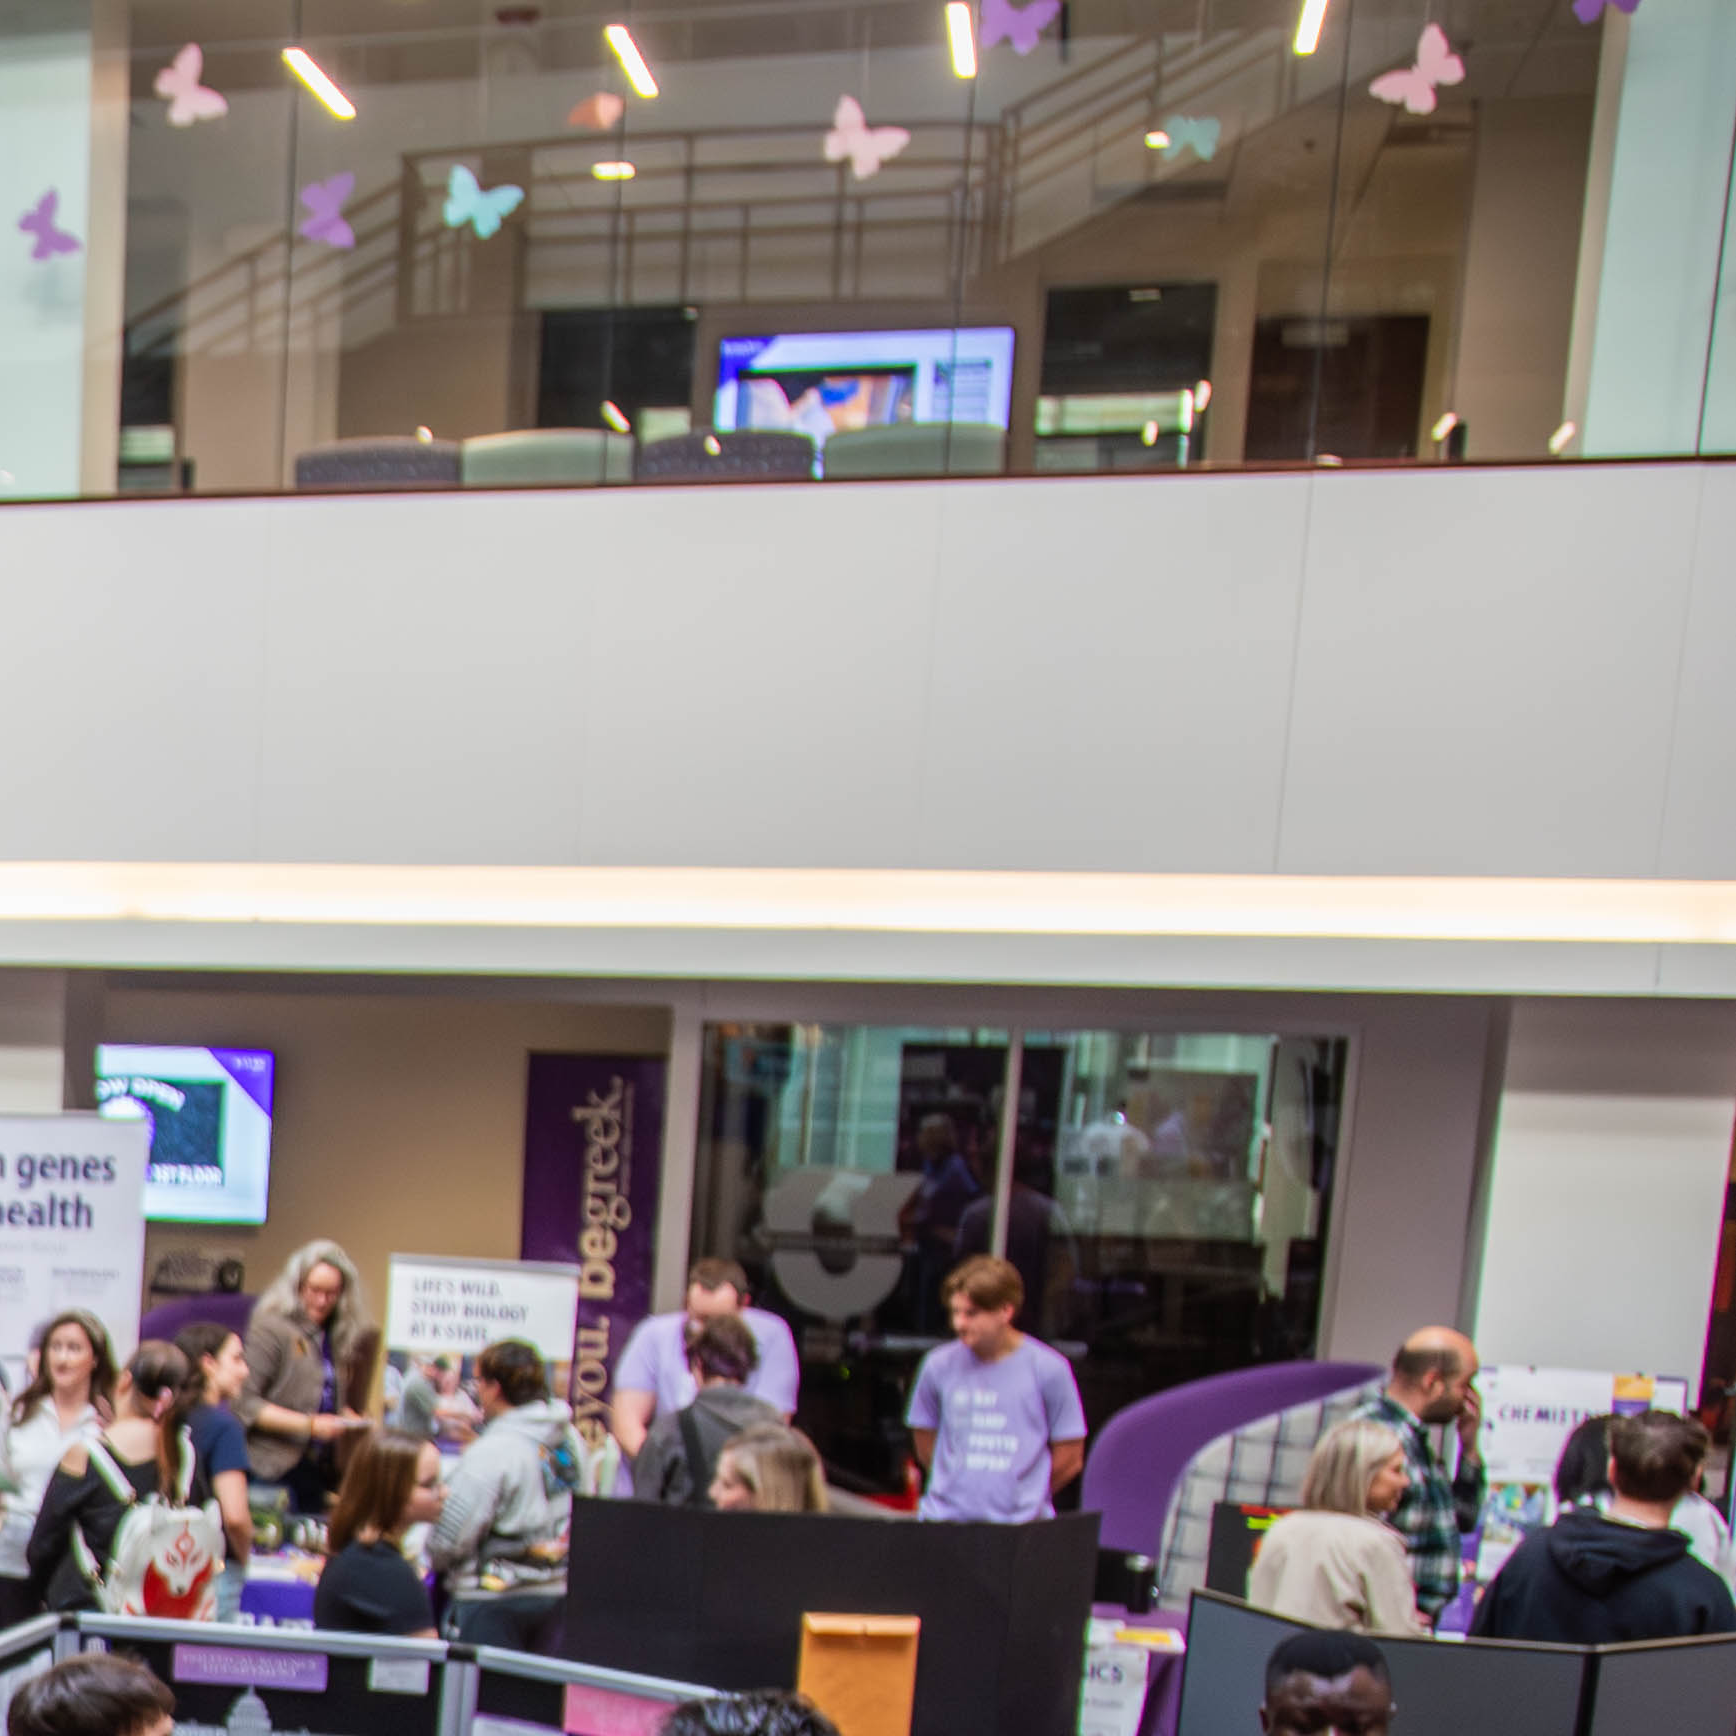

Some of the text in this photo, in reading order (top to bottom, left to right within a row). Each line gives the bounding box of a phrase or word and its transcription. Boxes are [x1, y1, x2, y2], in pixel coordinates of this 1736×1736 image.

[129, 1076, 186, 1113] OPEN
[17, 1152, 117, 1191] genes
[412, 1300, 528, 1324] STUDY BIOLOGY
